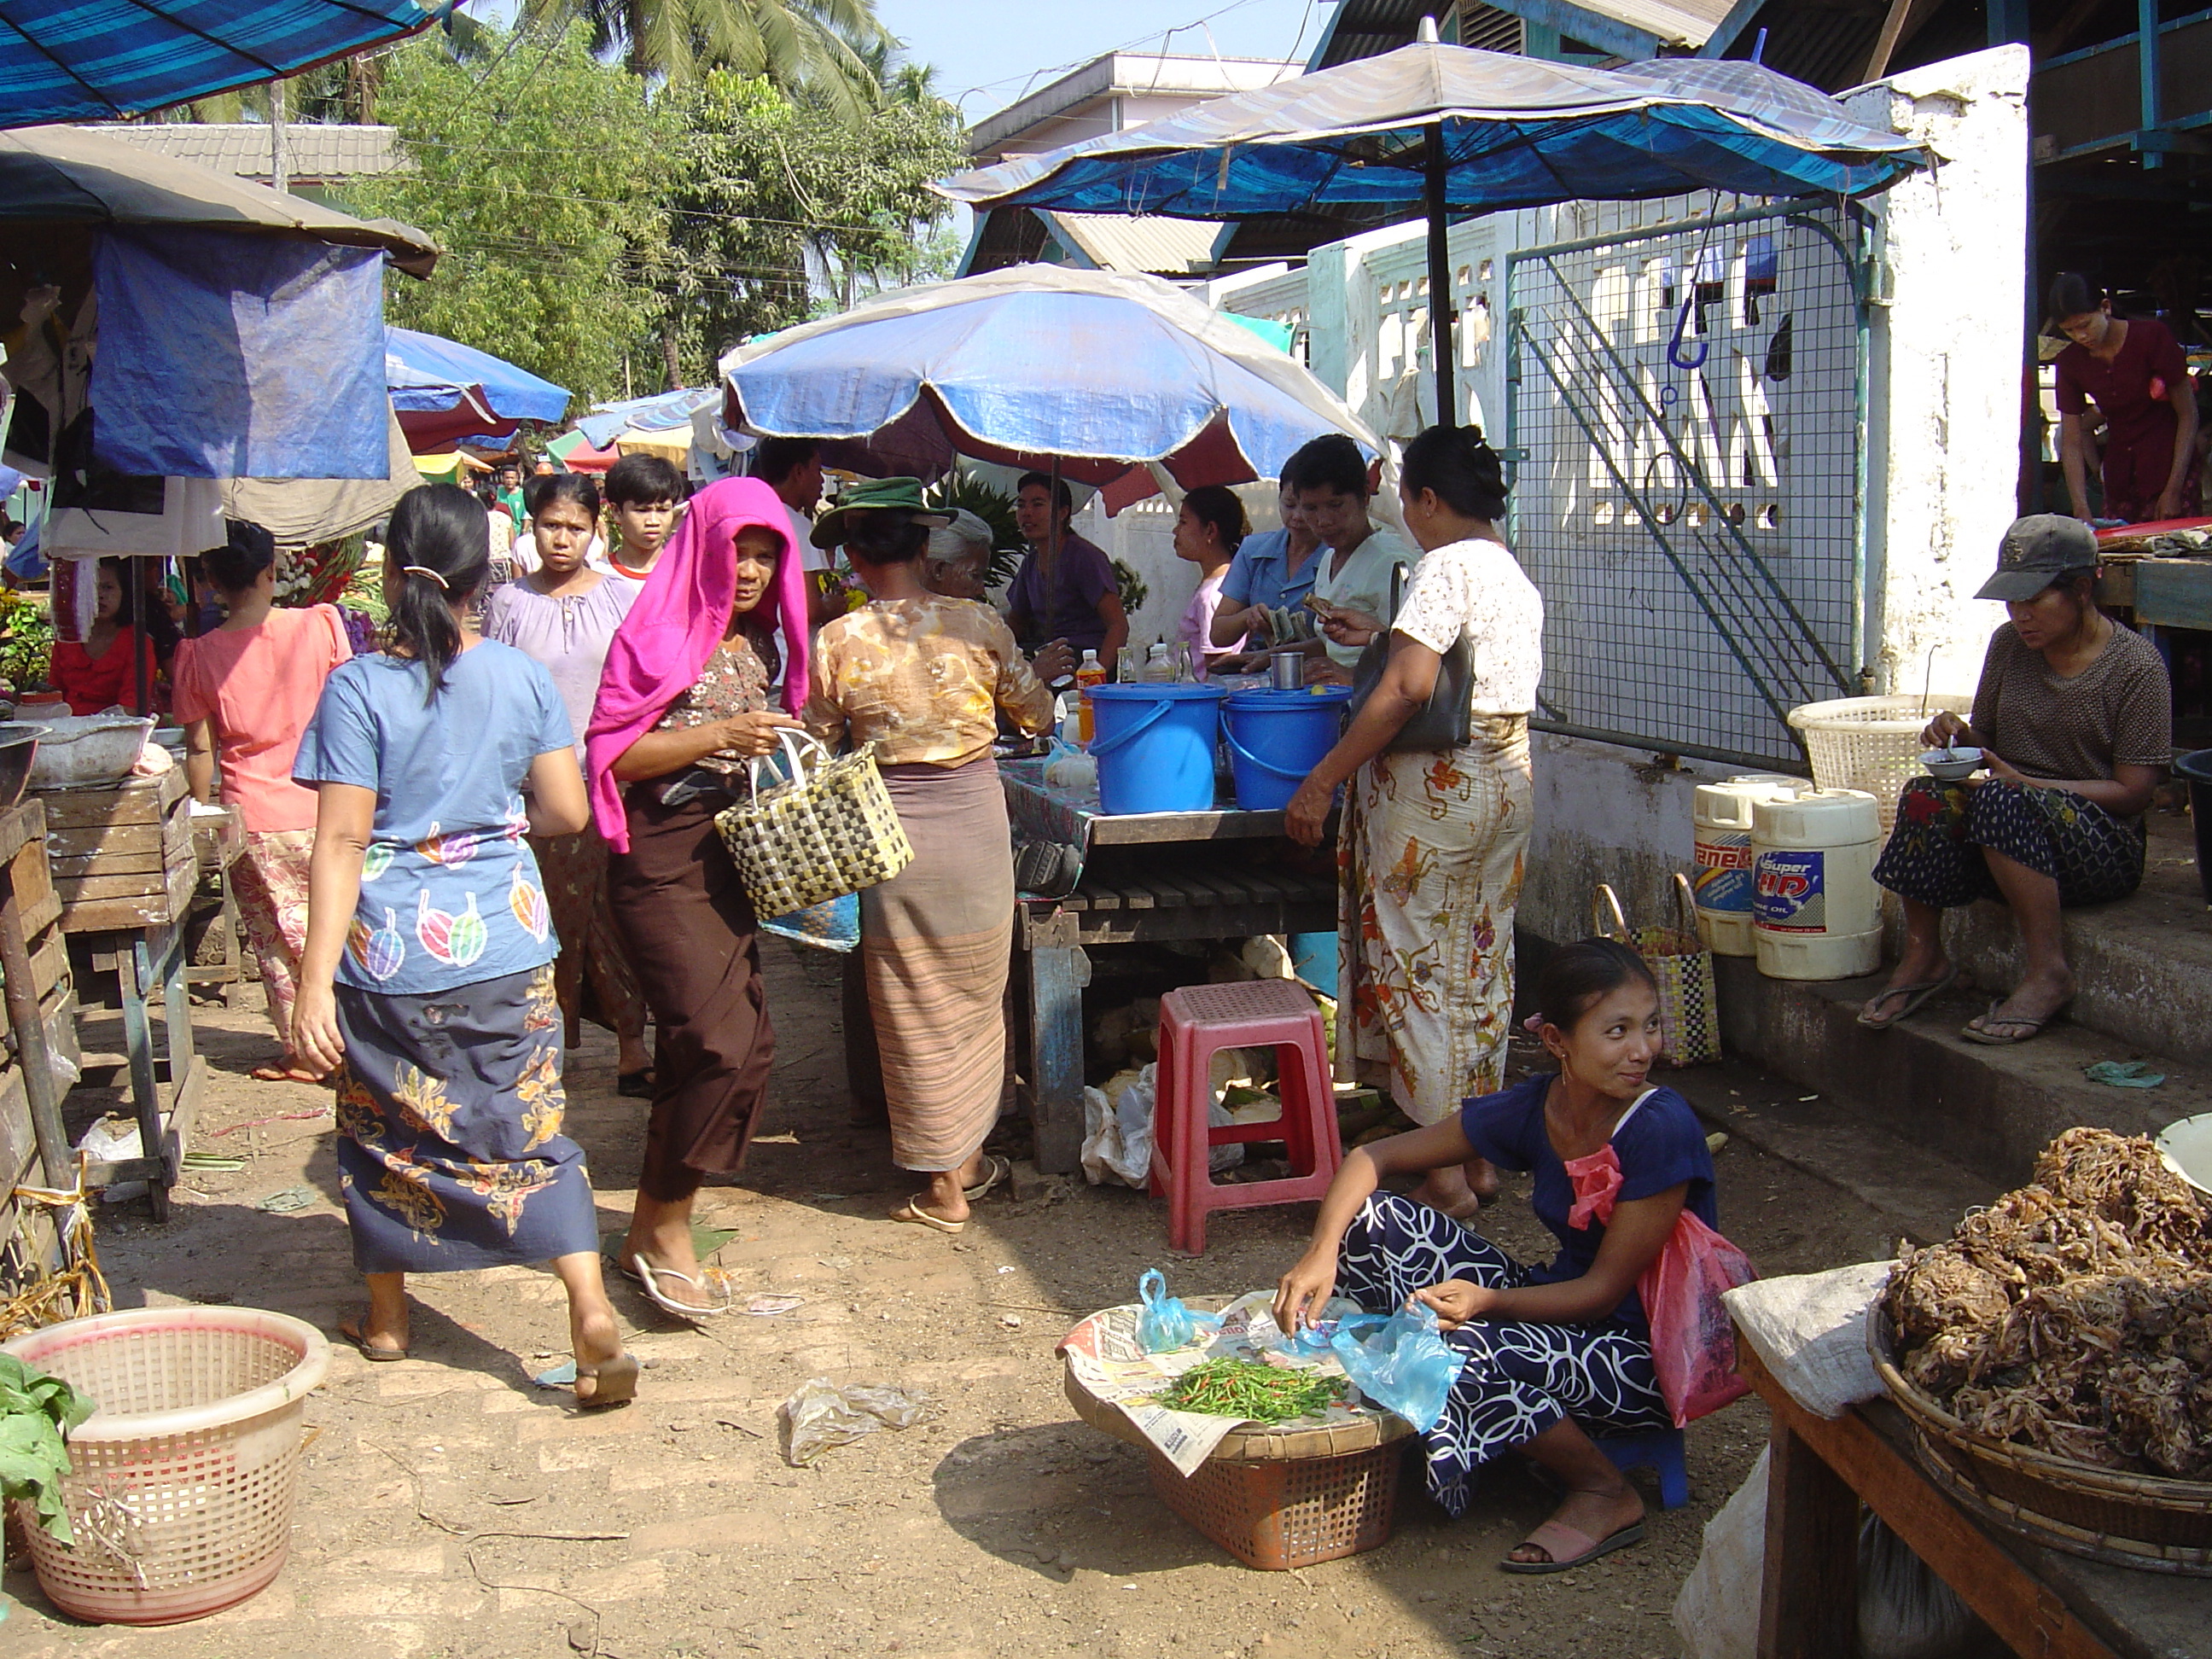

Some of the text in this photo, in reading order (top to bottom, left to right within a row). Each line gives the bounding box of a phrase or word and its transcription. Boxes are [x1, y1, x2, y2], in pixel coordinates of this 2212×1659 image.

[1761, 859, 1812, 874] Super
[1758, 872, 1810, 898] HD
[1770, 905, 1789, 914] OIL
